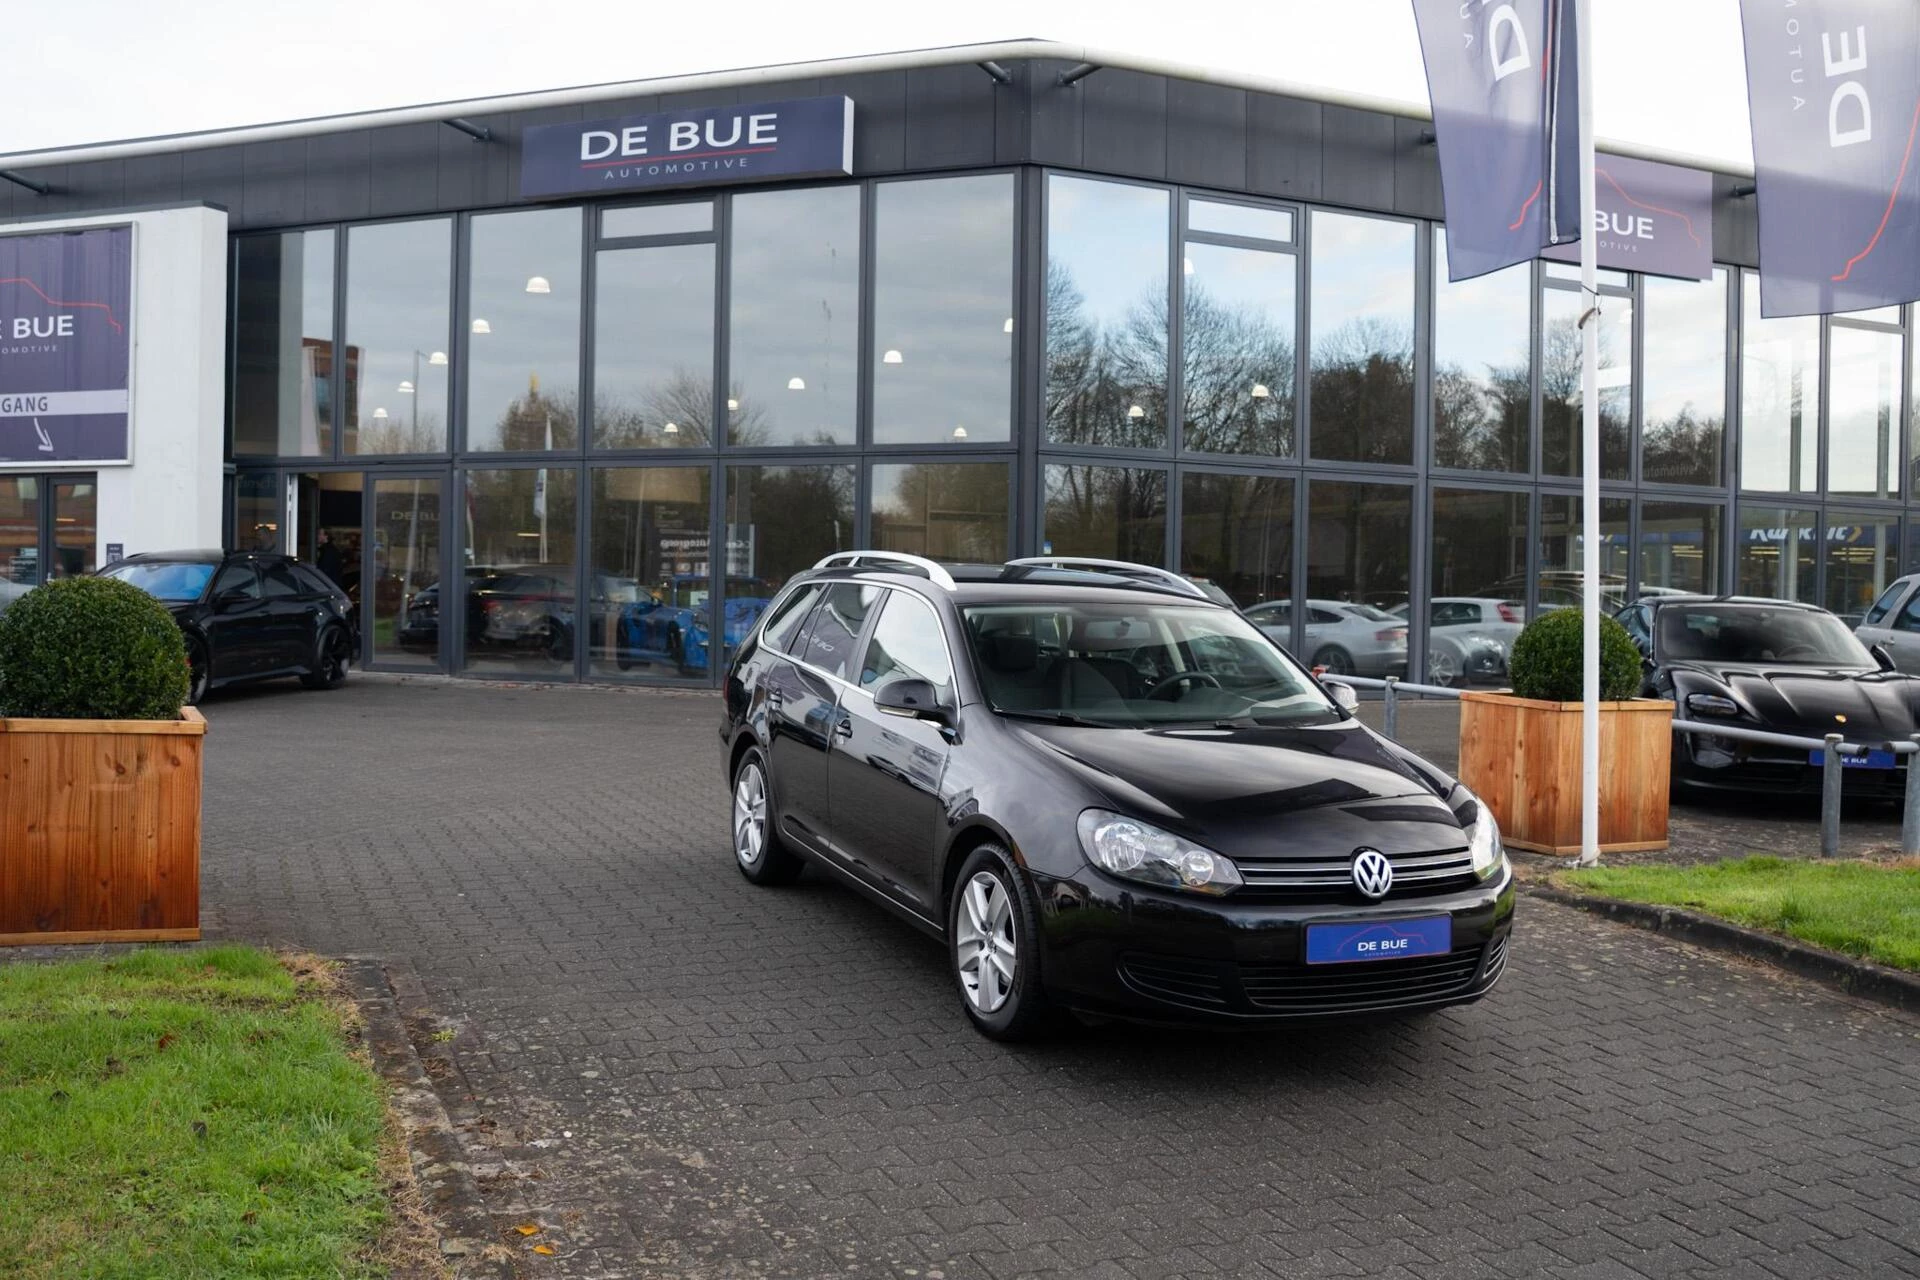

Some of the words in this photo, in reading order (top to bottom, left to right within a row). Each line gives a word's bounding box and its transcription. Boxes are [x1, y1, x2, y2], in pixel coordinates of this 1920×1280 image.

[581, 126, 648, 161] DE
[669, 113, 778, 152] BUE
[605, 157, 748, 180] AUTOMOTIVE
[1595, 209, 1654, 240] BUE
[1599, 240, 1638, 253] OTIVE
[13, 315, 74, 339] BUE
[1, 396, 48, 413] GANG
[1357, 941, 1377, 952] DE
[1381, 938, 1408, 950] BUE
